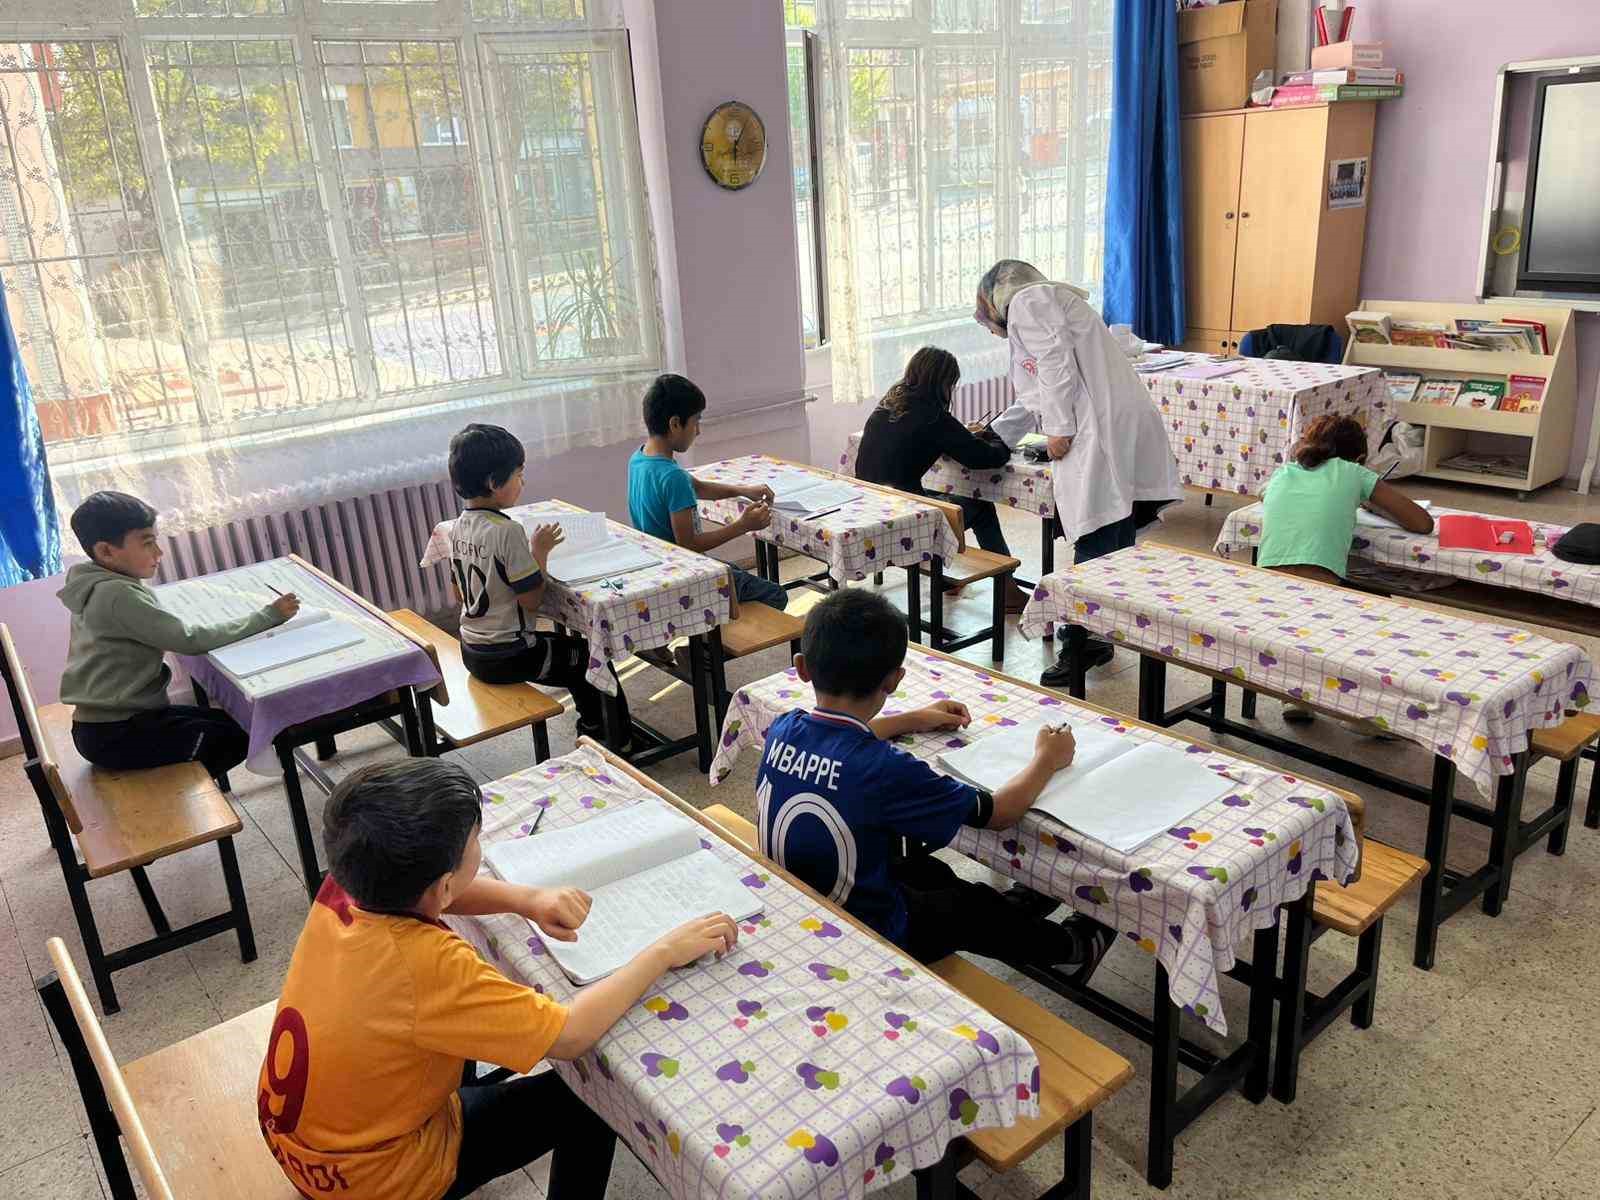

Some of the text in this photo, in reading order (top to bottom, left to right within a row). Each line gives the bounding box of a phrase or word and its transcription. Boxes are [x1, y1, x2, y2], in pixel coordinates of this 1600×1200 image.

[766, 740, 842, 790] MBAPPE
[757, 773, 856, 906] 10
[258, 1007, 309, 1134] 9
